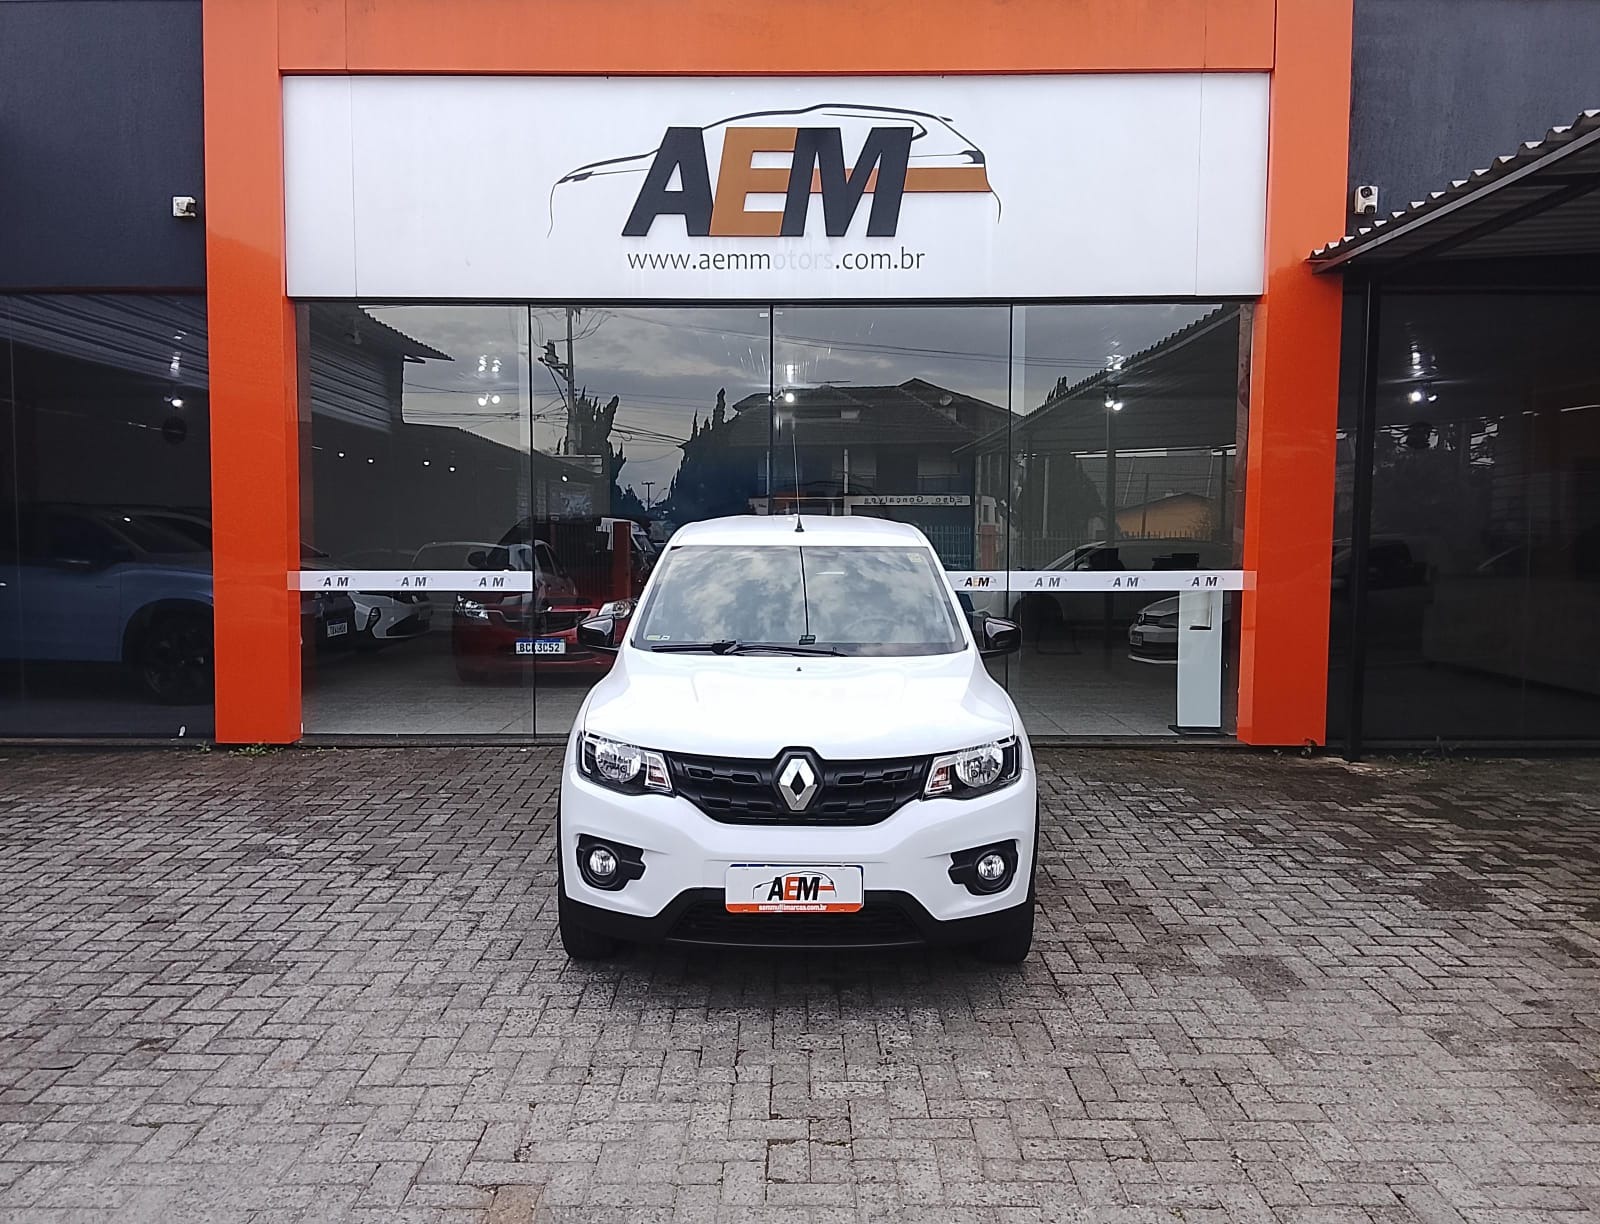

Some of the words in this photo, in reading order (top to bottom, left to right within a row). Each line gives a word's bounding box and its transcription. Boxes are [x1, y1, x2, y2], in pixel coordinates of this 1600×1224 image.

[621, 126, 914, 237] AEM
[627, 247, 925, 270] www.aemmotors.com.br
[767, 876, 821, 901] AEM
